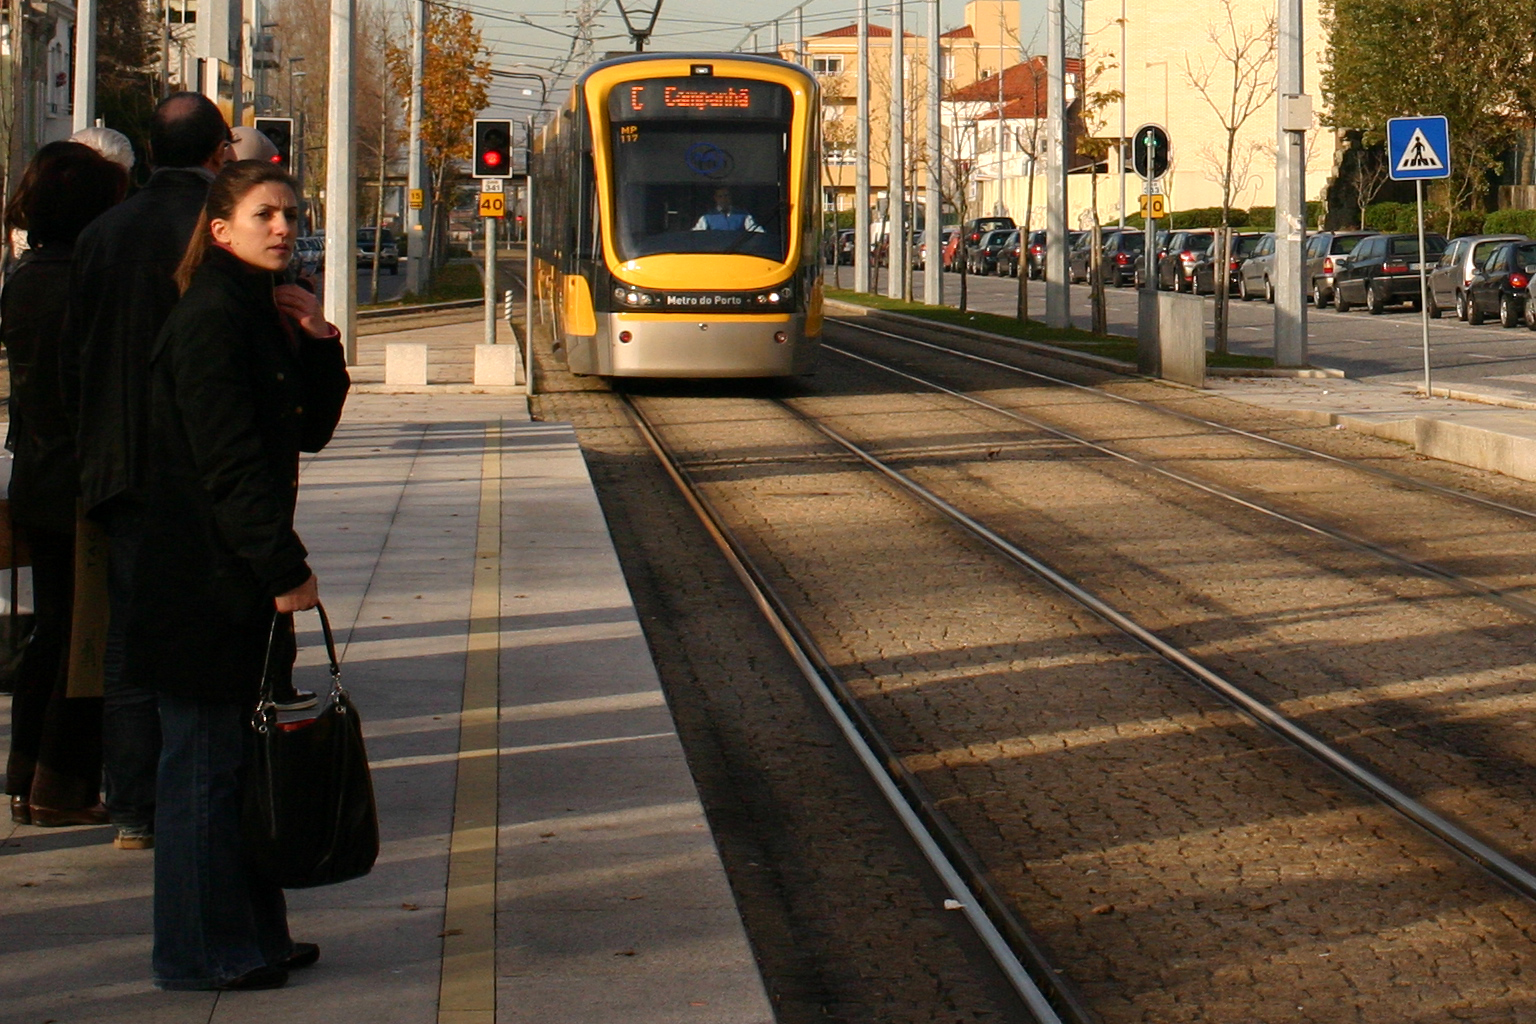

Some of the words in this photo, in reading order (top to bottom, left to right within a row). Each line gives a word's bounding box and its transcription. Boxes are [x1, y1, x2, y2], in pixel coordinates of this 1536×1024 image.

[631, 86, 645, 110] C
[620, 125, 638, 135] MP
[620, 135, 639, 143] 117
[481, 199, 503, 211] 40
[667, 295, 698, 305] Metro
[699, 296, 712, 305] do
[714, 296, 742, 305] Porto
